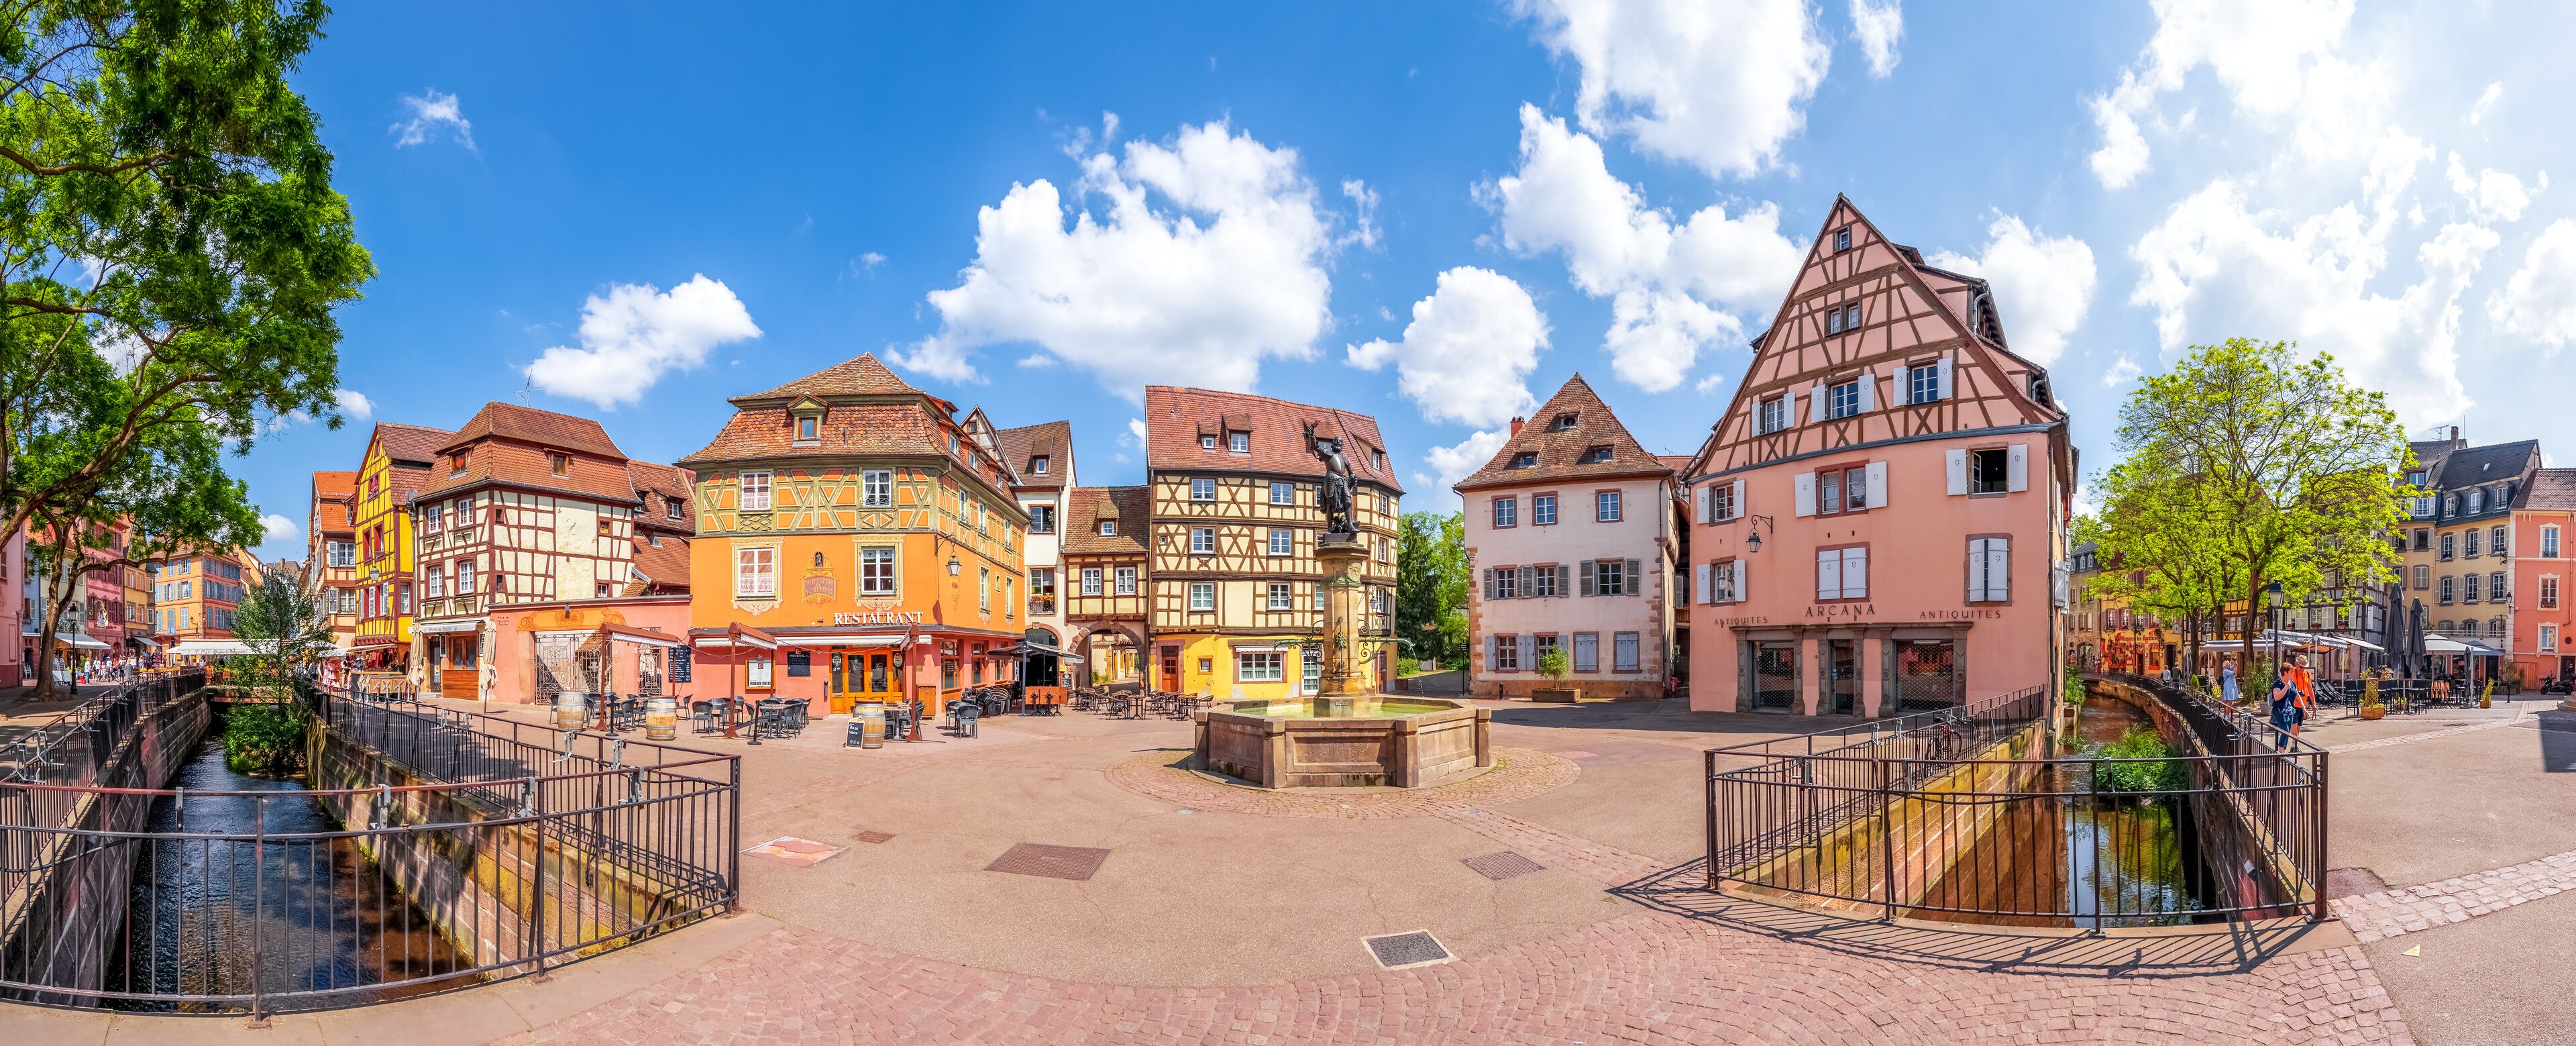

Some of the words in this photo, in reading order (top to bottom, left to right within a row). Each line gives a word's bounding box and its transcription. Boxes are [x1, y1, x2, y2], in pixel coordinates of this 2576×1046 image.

[1805, 603, 1875, 617] ARCANA
[1919, 610, 2001, 619] ANTIQUITES
[834, 611, 924, 625] RESTAURANT
[1713, 616, 1768, 625] ANTIQUITES
